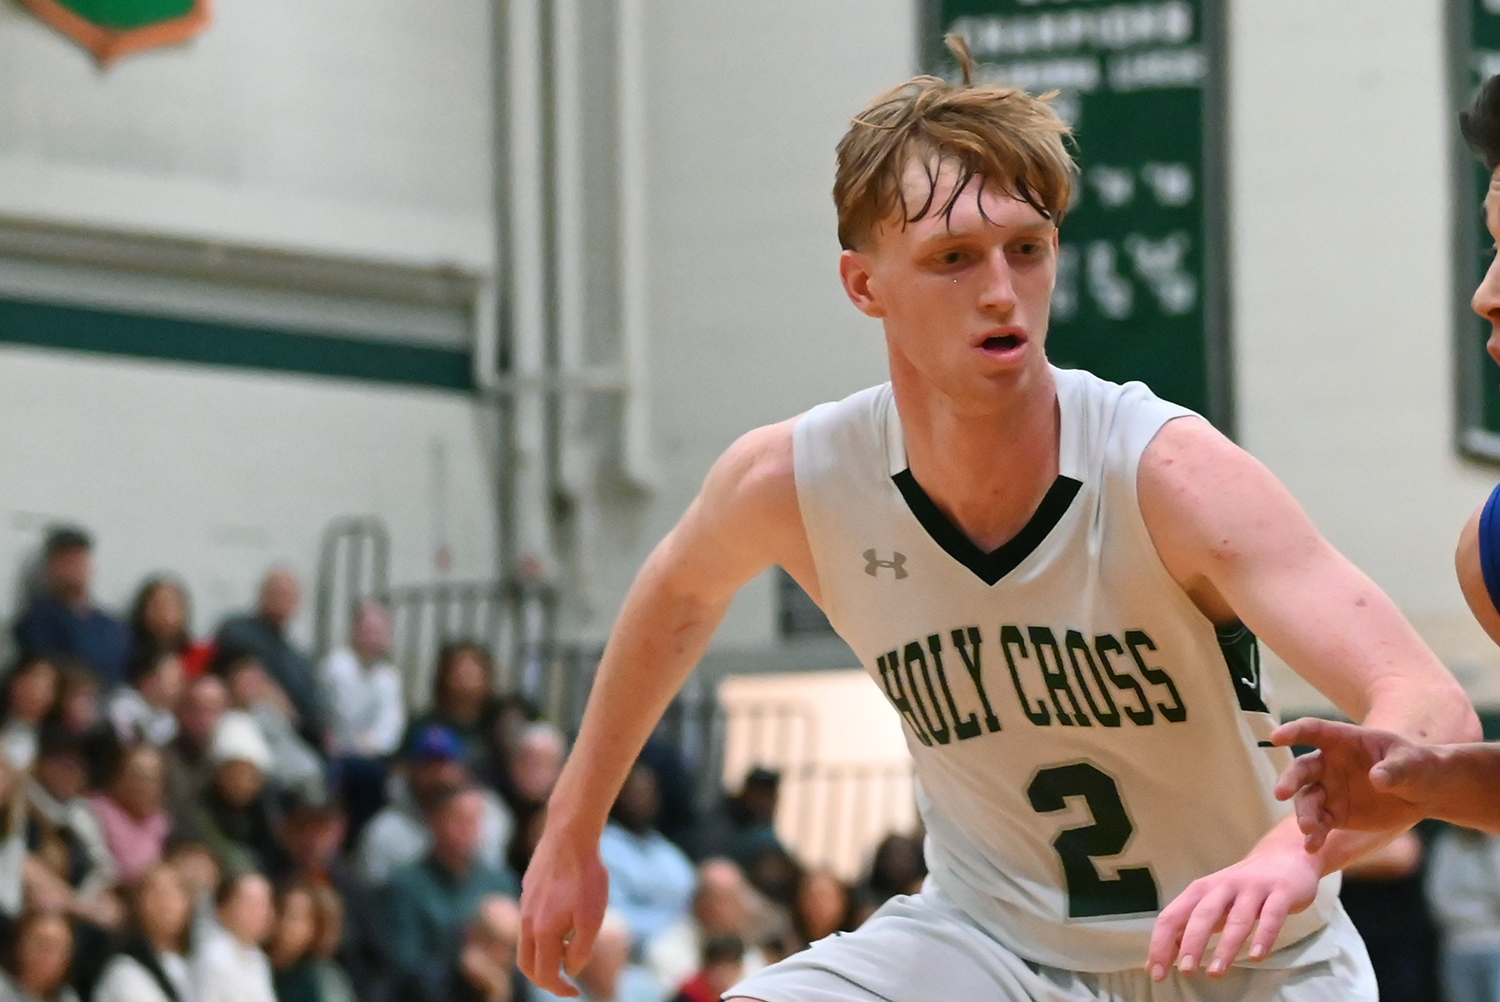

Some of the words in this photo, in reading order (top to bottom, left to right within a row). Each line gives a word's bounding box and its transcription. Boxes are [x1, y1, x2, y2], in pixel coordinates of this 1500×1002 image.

[876, 626, 1002, 747] HOLY
[1000, 624, 1187, 728] CROSS
[1024, 759, 1160, 920] 2
